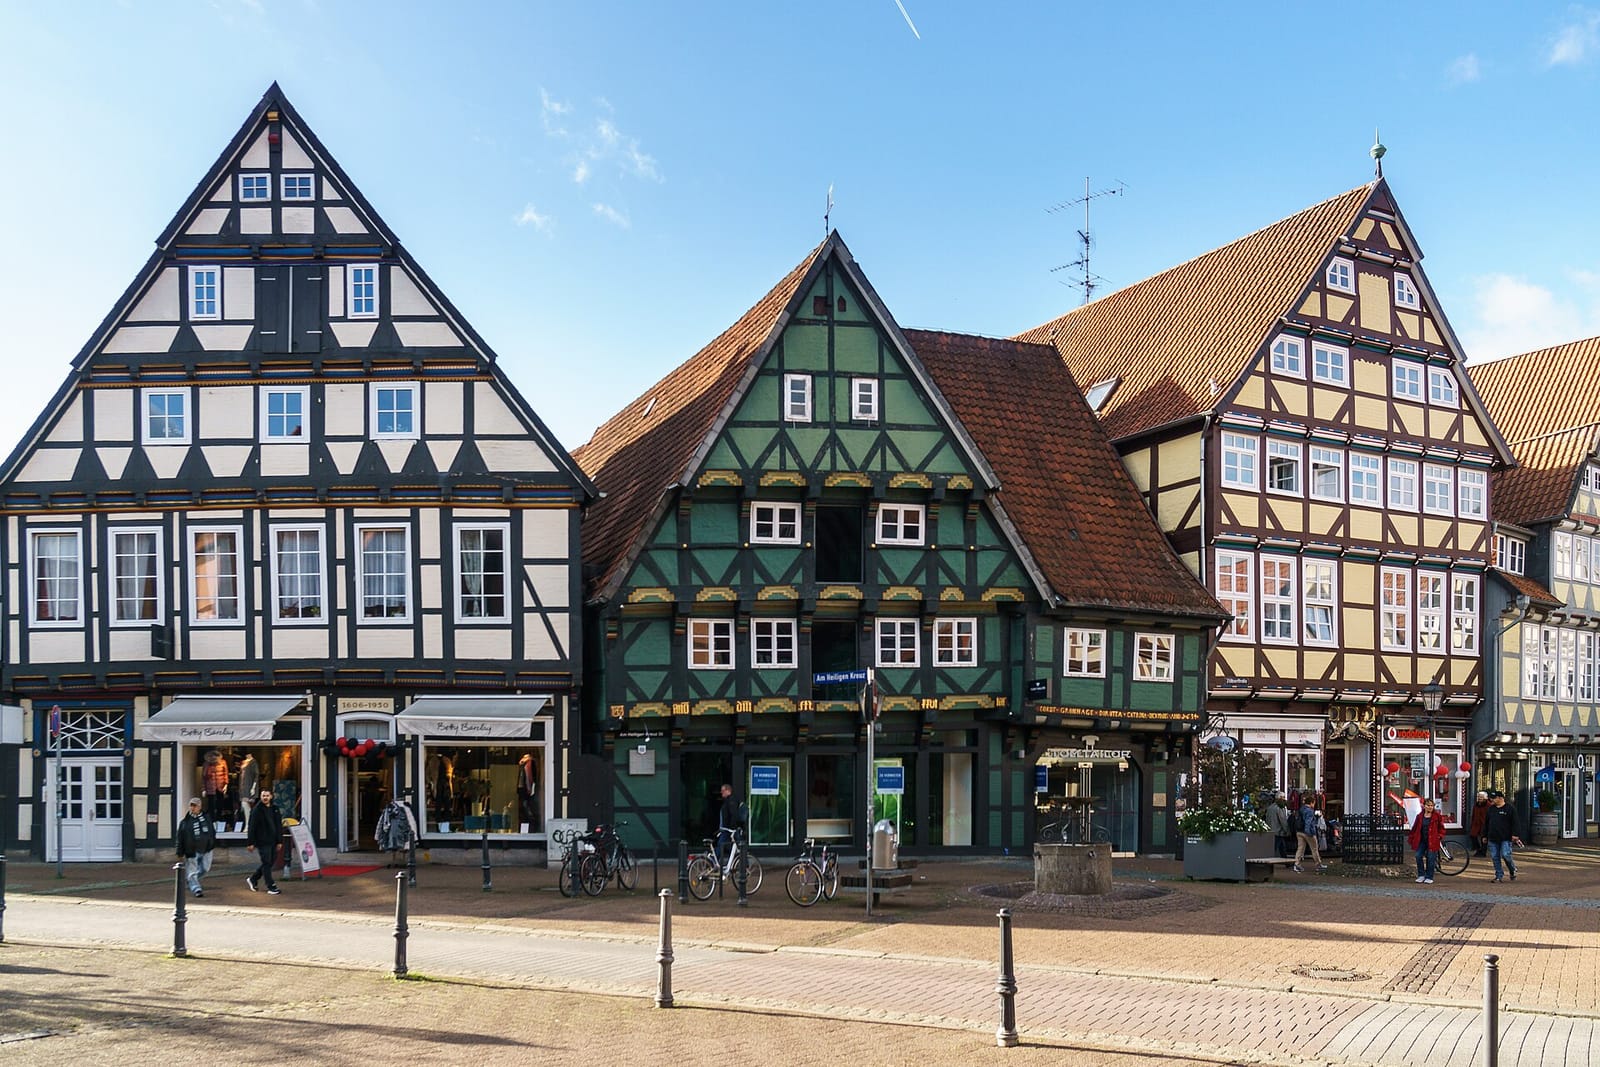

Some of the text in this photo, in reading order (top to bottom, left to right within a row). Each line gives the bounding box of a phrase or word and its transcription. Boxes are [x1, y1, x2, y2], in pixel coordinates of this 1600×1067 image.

[827, 673, 849, 682] Heiligen
[180, 727, 234, 740] Betty Barclay
[437, 722, 492, 736] Betty Barclay
[1397, 728, 1430, 738] vodafone
